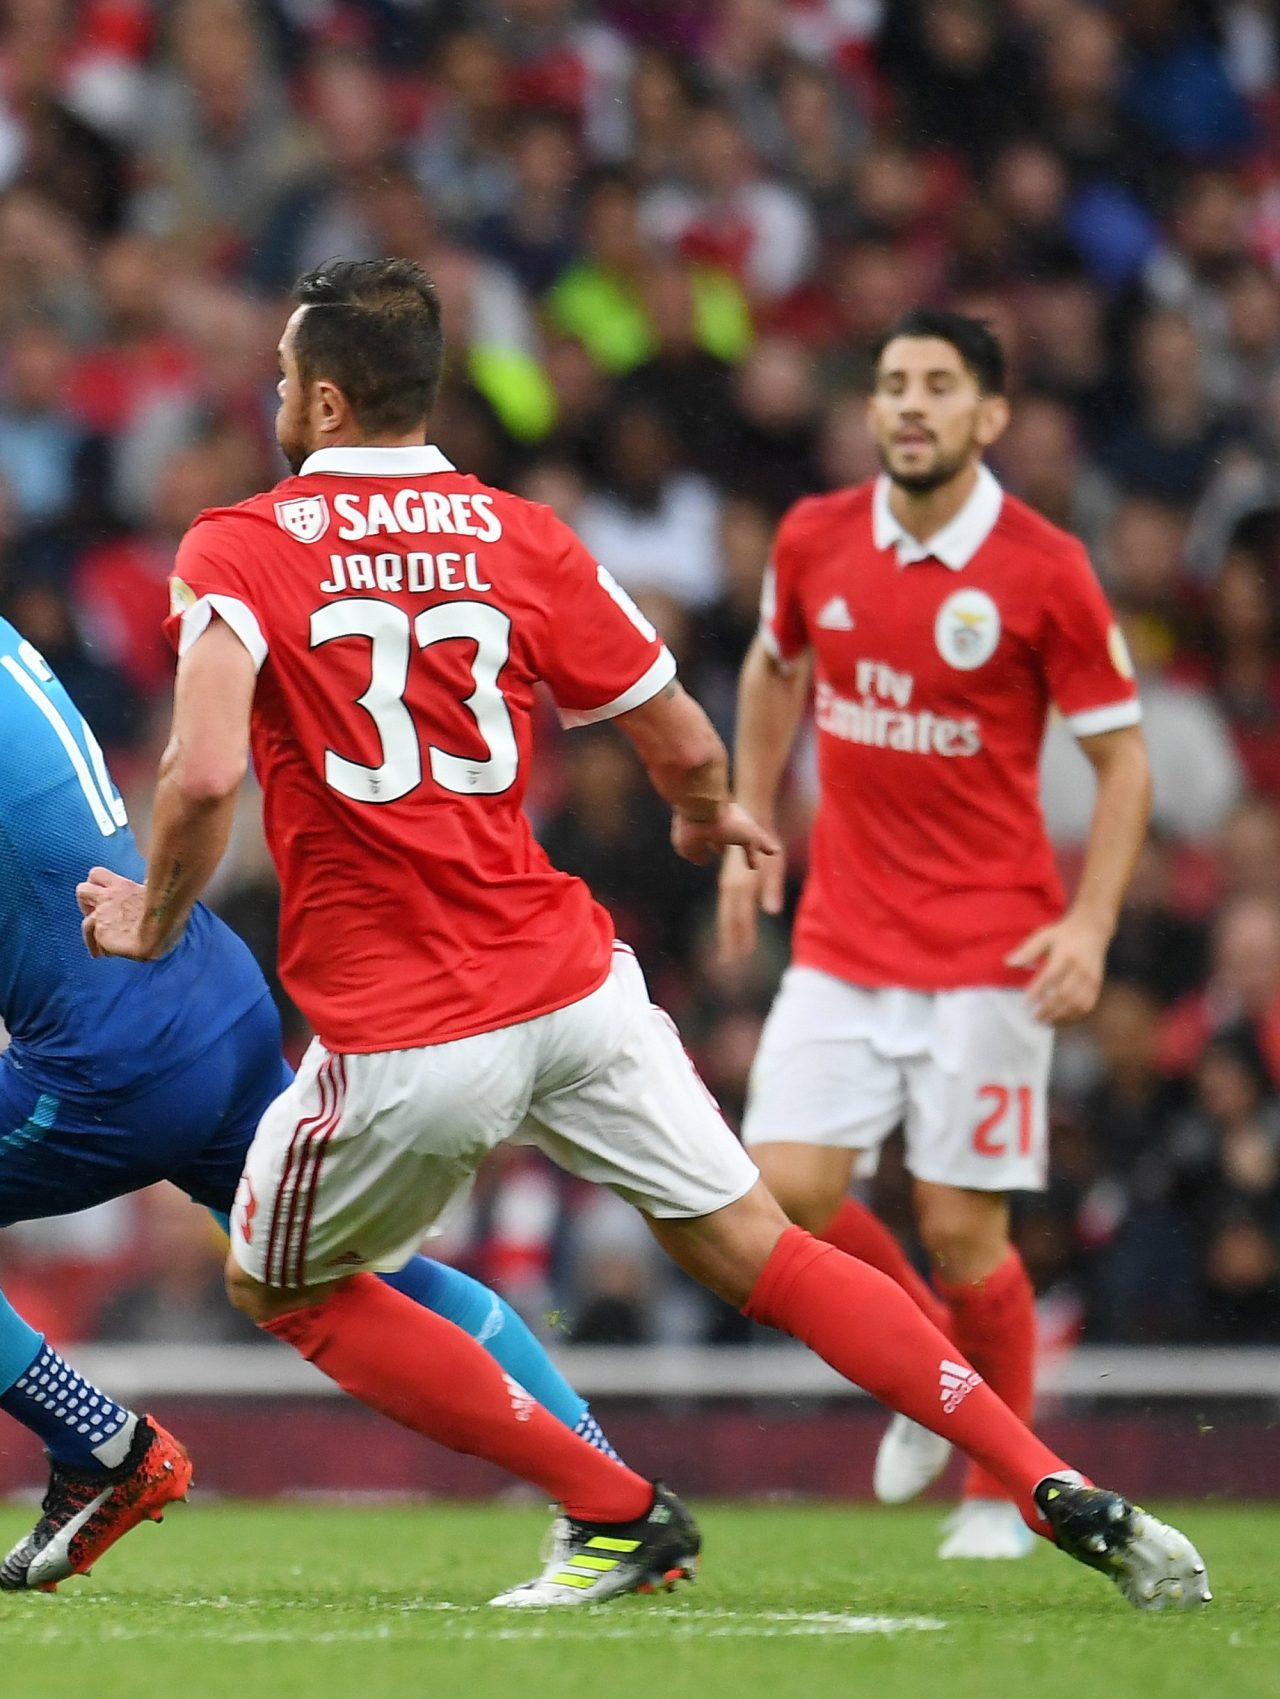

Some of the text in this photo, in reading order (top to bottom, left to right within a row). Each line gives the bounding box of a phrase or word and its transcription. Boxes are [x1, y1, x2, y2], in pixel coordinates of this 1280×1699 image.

[334, 488, 502, 543] SAGRES
[319, 551, 492, 594] JARDEL
[309, 596, 519, 804] 33
[855, 660, 914, 709] Fly
[816, 682, 982, 758] Emirates
[971, 1083, 1032, 1159] 21
